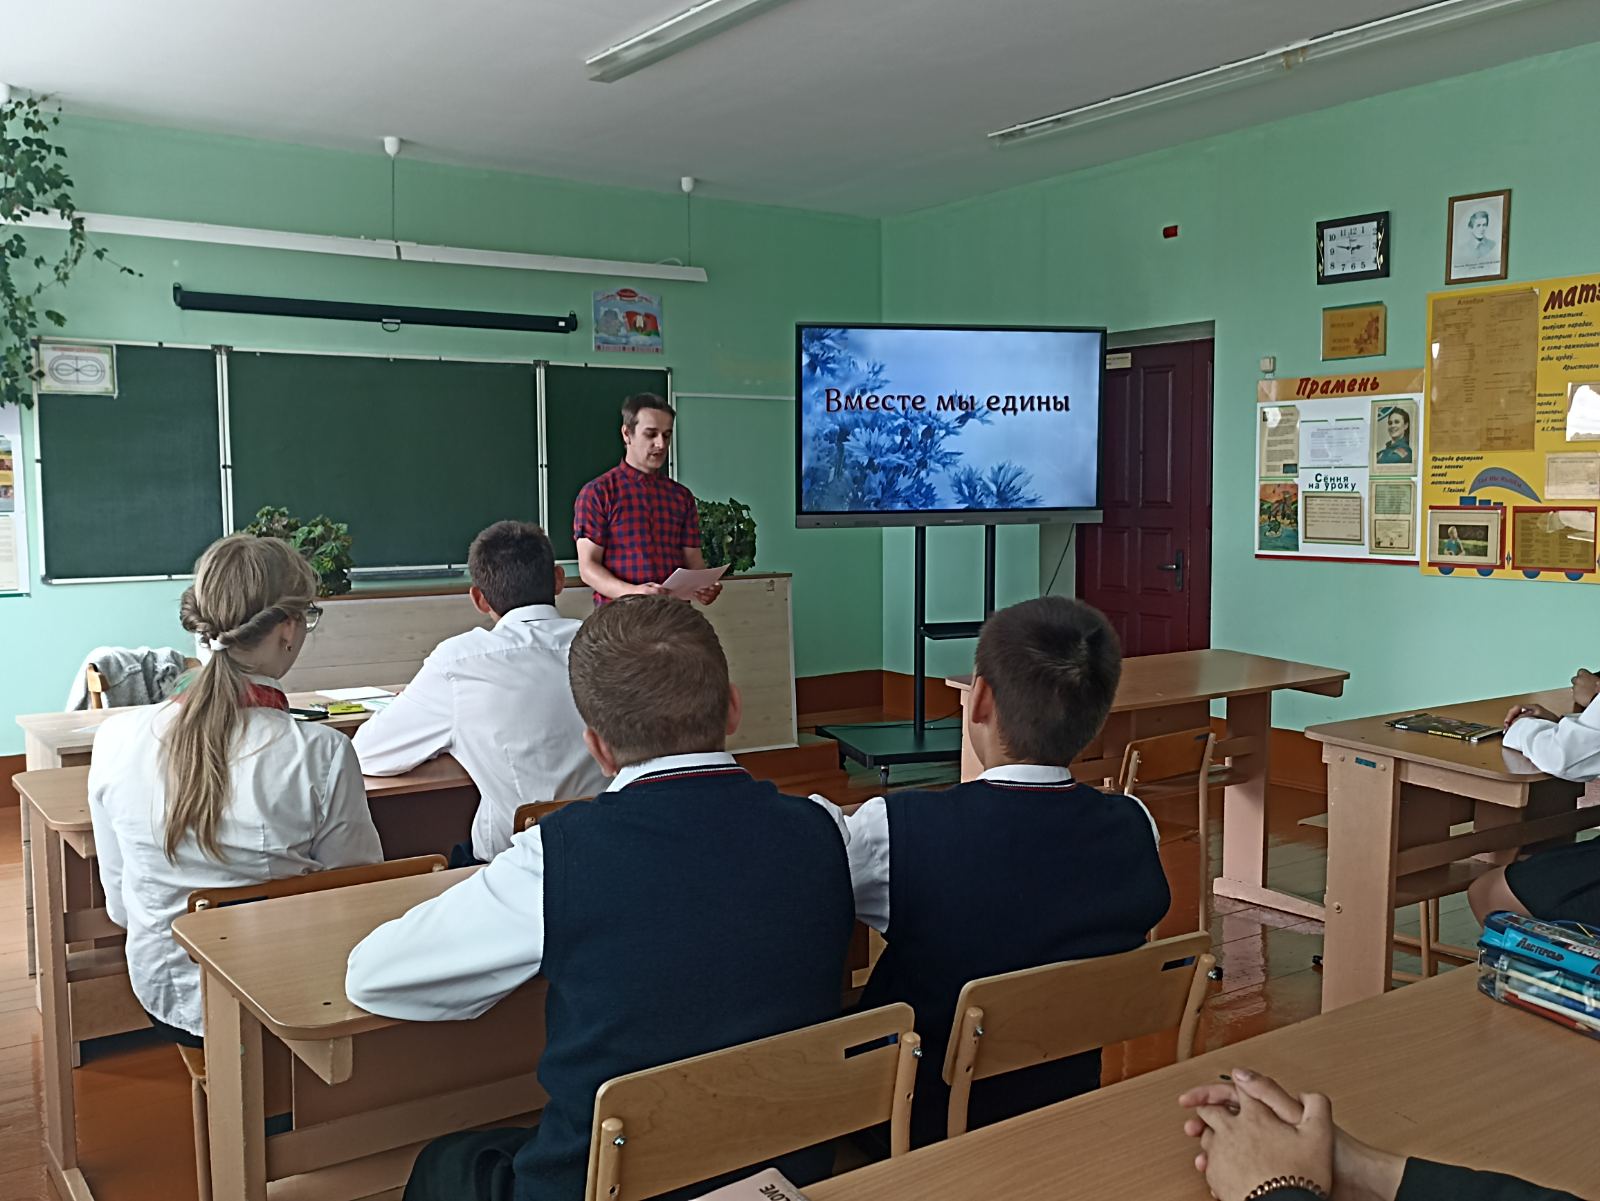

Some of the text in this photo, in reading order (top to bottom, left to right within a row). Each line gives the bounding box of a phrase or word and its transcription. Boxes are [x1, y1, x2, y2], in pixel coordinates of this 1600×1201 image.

[1340, 229, 1346, 237] 11
[1349, 227, 1357, 235] 12
[1329, 233, 1336, 241] 10
[1329, 262, 1335, 270] 8
[1340, 263, 1346, 271] 7
[1350, 262, 1356, 270] 6
[1360, 261, 1366, 269] 5
[1296, 376, 1380, 399] Прамень
[824, 388, 1070, 416] Вместе мы едины
[1314, 473, 1349, 484] Сёння
